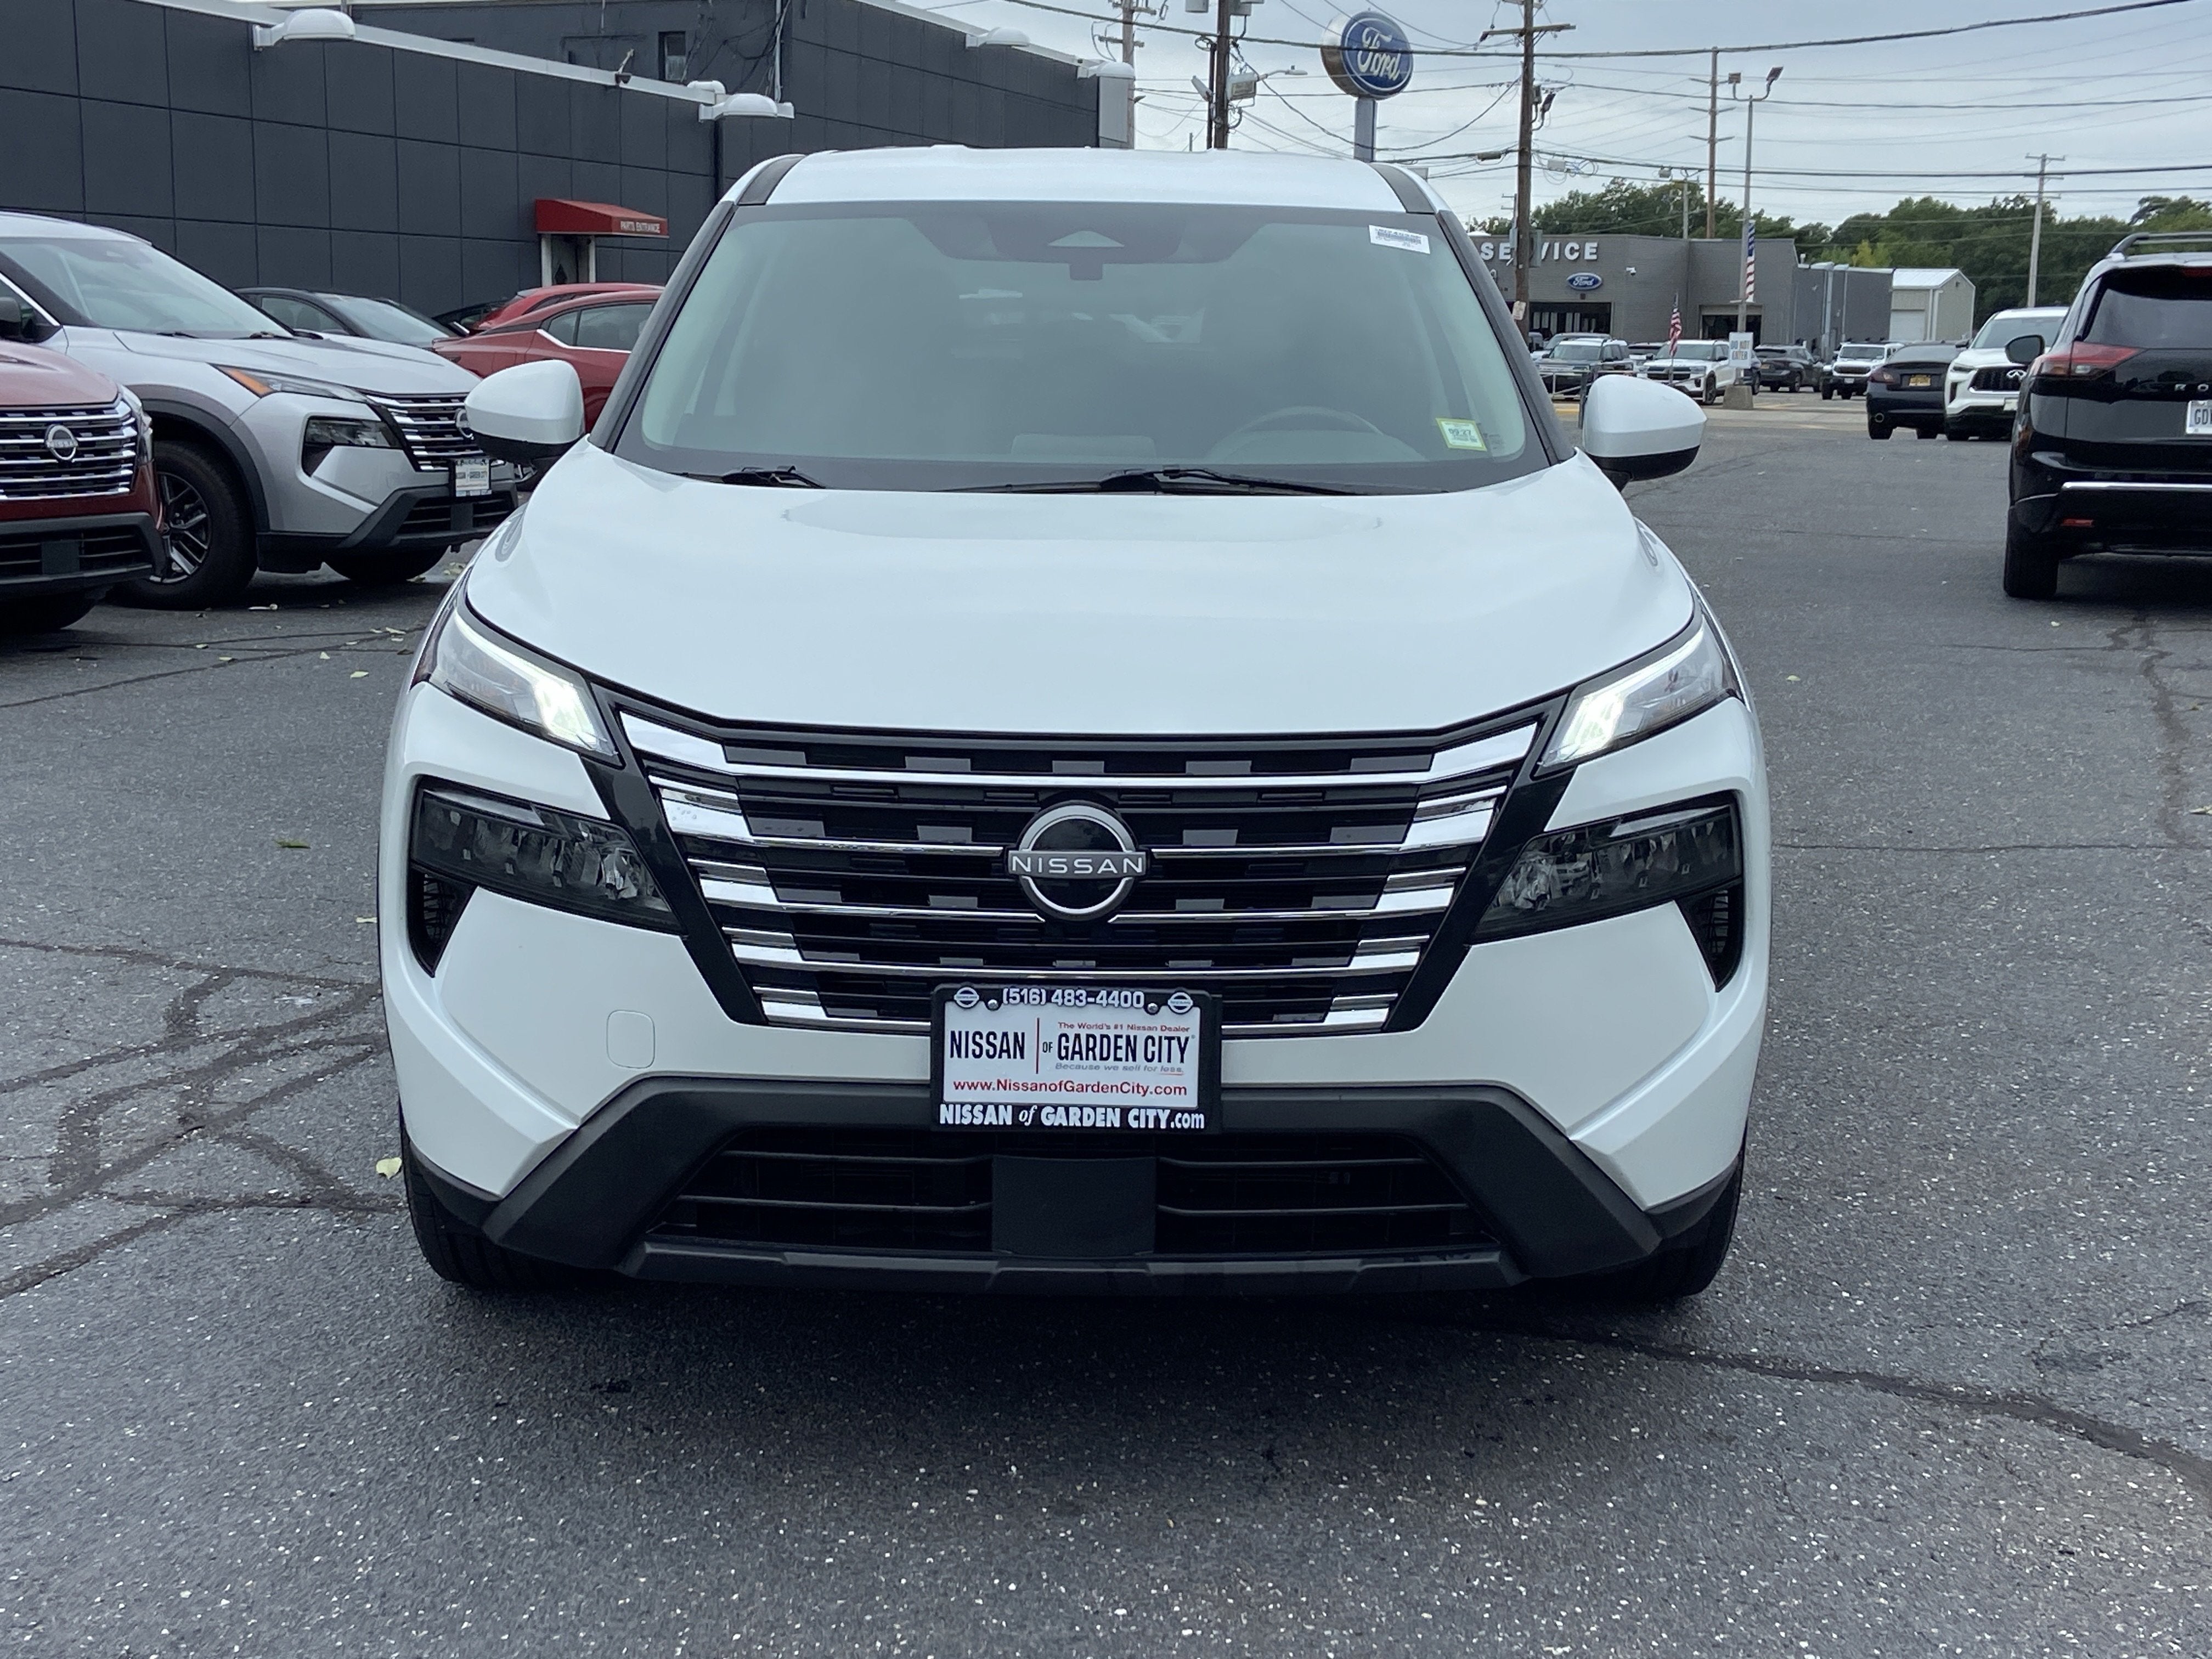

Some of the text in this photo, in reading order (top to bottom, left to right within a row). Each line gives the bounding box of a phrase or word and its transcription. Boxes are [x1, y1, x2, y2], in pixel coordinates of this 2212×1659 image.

[1357, 27, 1401, 81] Ford
[1481, 242, 1598, 261] SEVICE
[1572, 275, 1595, 286] Ford
[2195, 408, 2212, 425] GD
[1012, 856, 1142, 874] NISSAN
[1002, 988, 1144, 1008] (516) 483-4400
[1077, 1022, 1111, 1030] World's
[950, 1030, 1189, 1064] NISSAN OF GARDEN CITY
[1055, 1063, 1100, 1071] Because
[953, 1079, 1187, 1097] www.NissanofGardenCity.com
[940, 1104, 1205, 1129] NISSAN of GARDEN CITY.com
